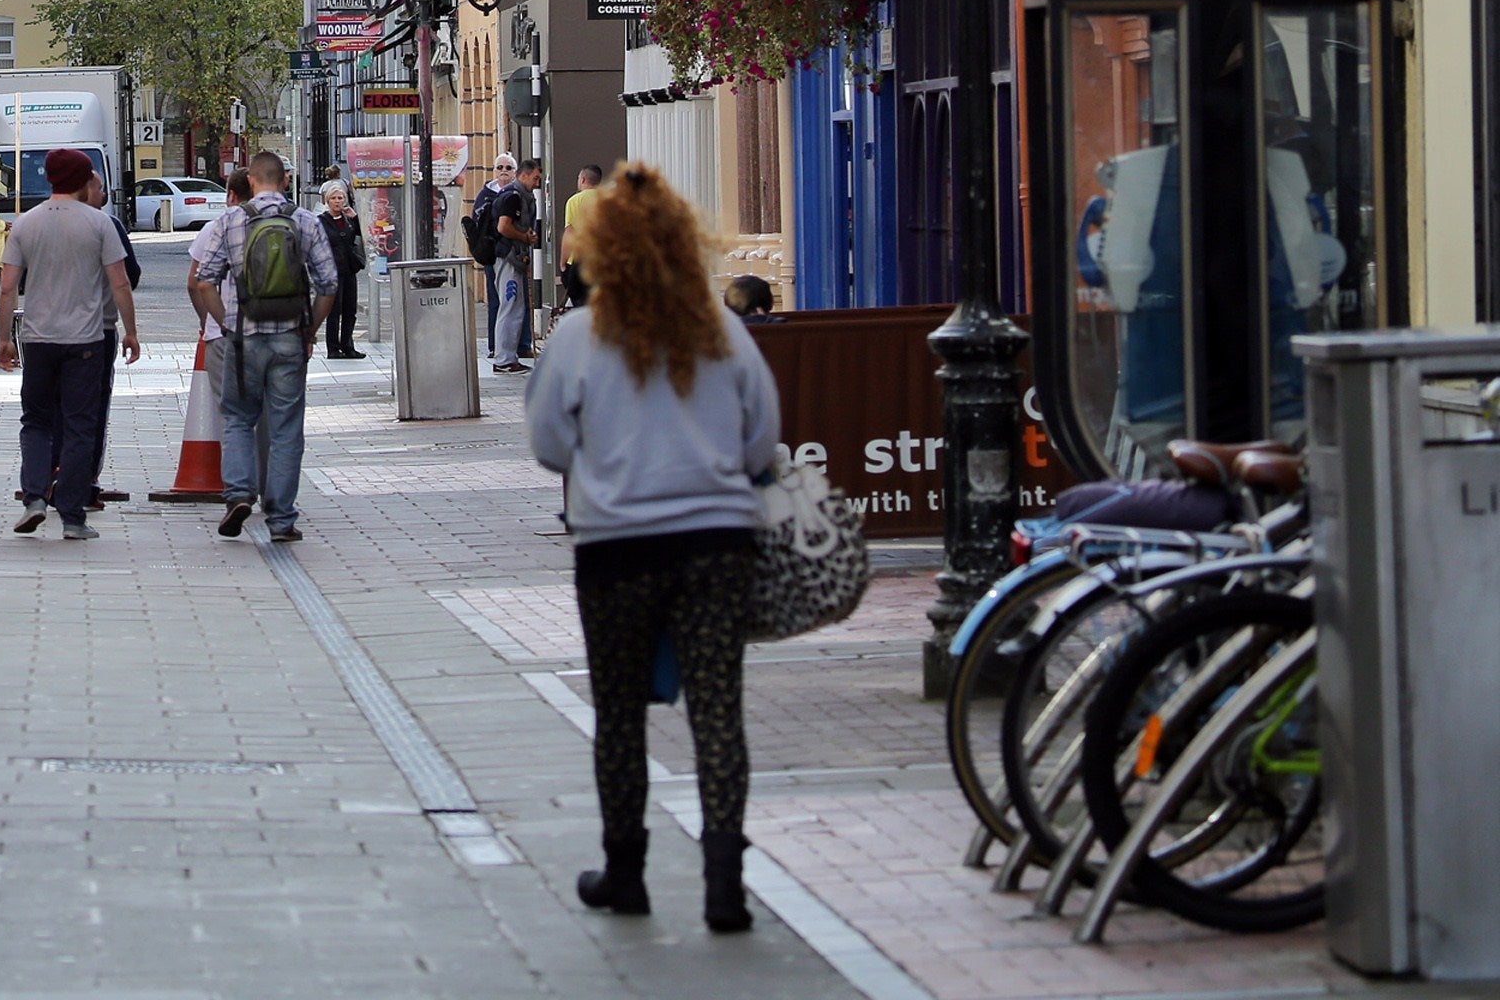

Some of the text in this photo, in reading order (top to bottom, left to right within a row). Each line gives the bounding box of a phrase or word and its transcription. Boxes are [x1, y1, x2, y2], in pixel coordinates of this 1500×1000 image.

[318, 24, 363, 36] WOODWA
[363, 94, 420, 108] FLORIST
[143, 126, 159, 142] 21
[420, 297, 450, 307] Litter
[846, 490, 912, 514] with
